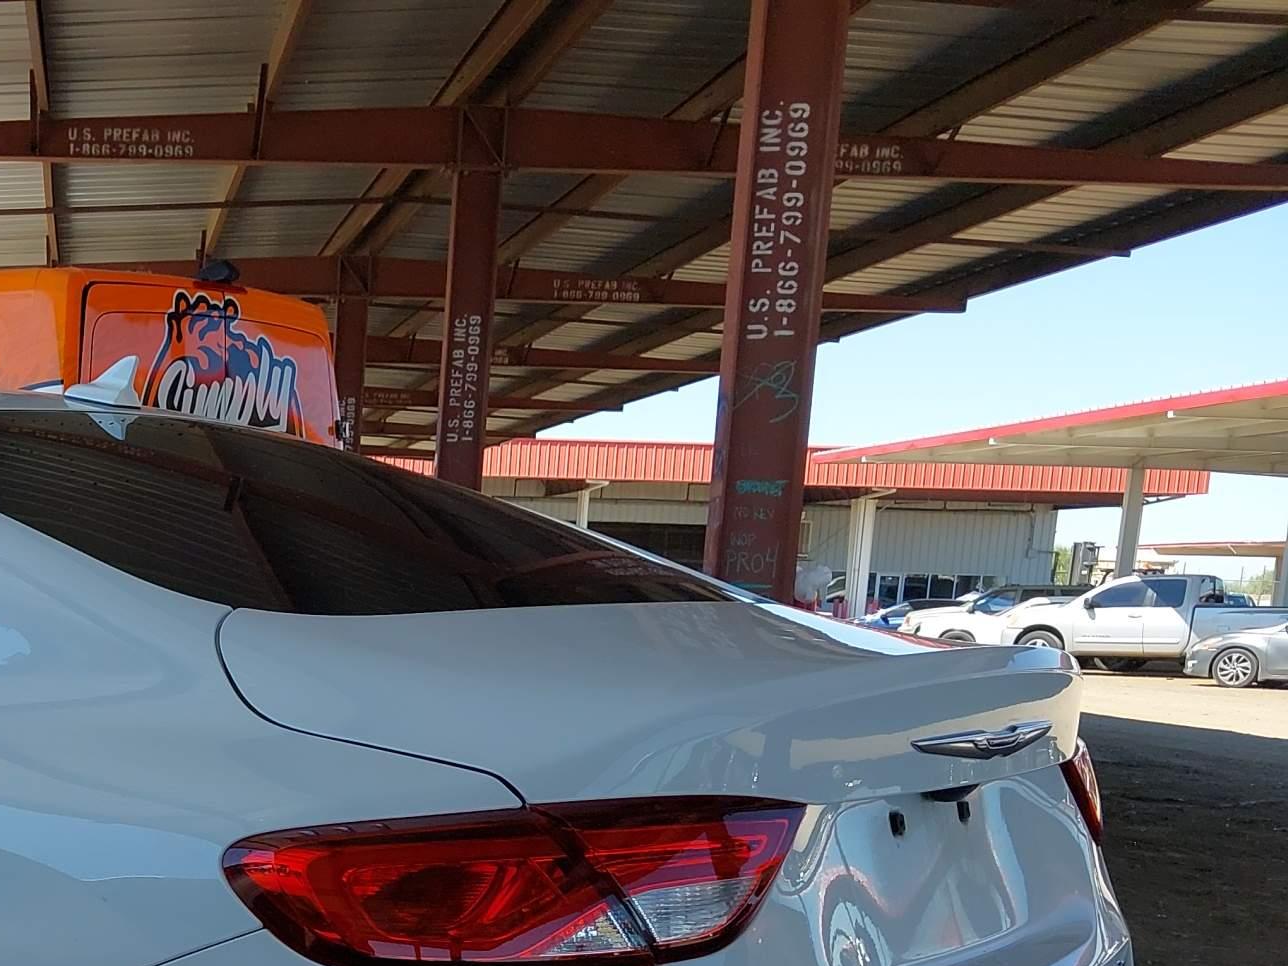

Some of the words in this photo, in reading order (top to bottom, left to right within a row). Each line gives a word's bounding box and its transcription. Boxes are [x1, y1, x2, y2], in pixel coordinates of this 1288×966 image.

[68, 128, 95, 142] U.S.
[104, 128, 160, 142] PREFAB
[167, 130, 195, 143] INC.
[69, 143, 194, 157] 1-866-799-0969
[760, 100, 785, 152] INC.
[875, 144, 904, 159] INC.
[752, 168, 779, 273] PREFAB
[774, 102, 810, 337] 1-866-799-0969
[454, 314, 467, 341] INC.
[746, 290, 771, 340] U.S.
[449, 349, 464, 407] PREFAB
[462, 315, 481, 441] 1-866-799-0969
[446, 415, 460, 442] U.S.
